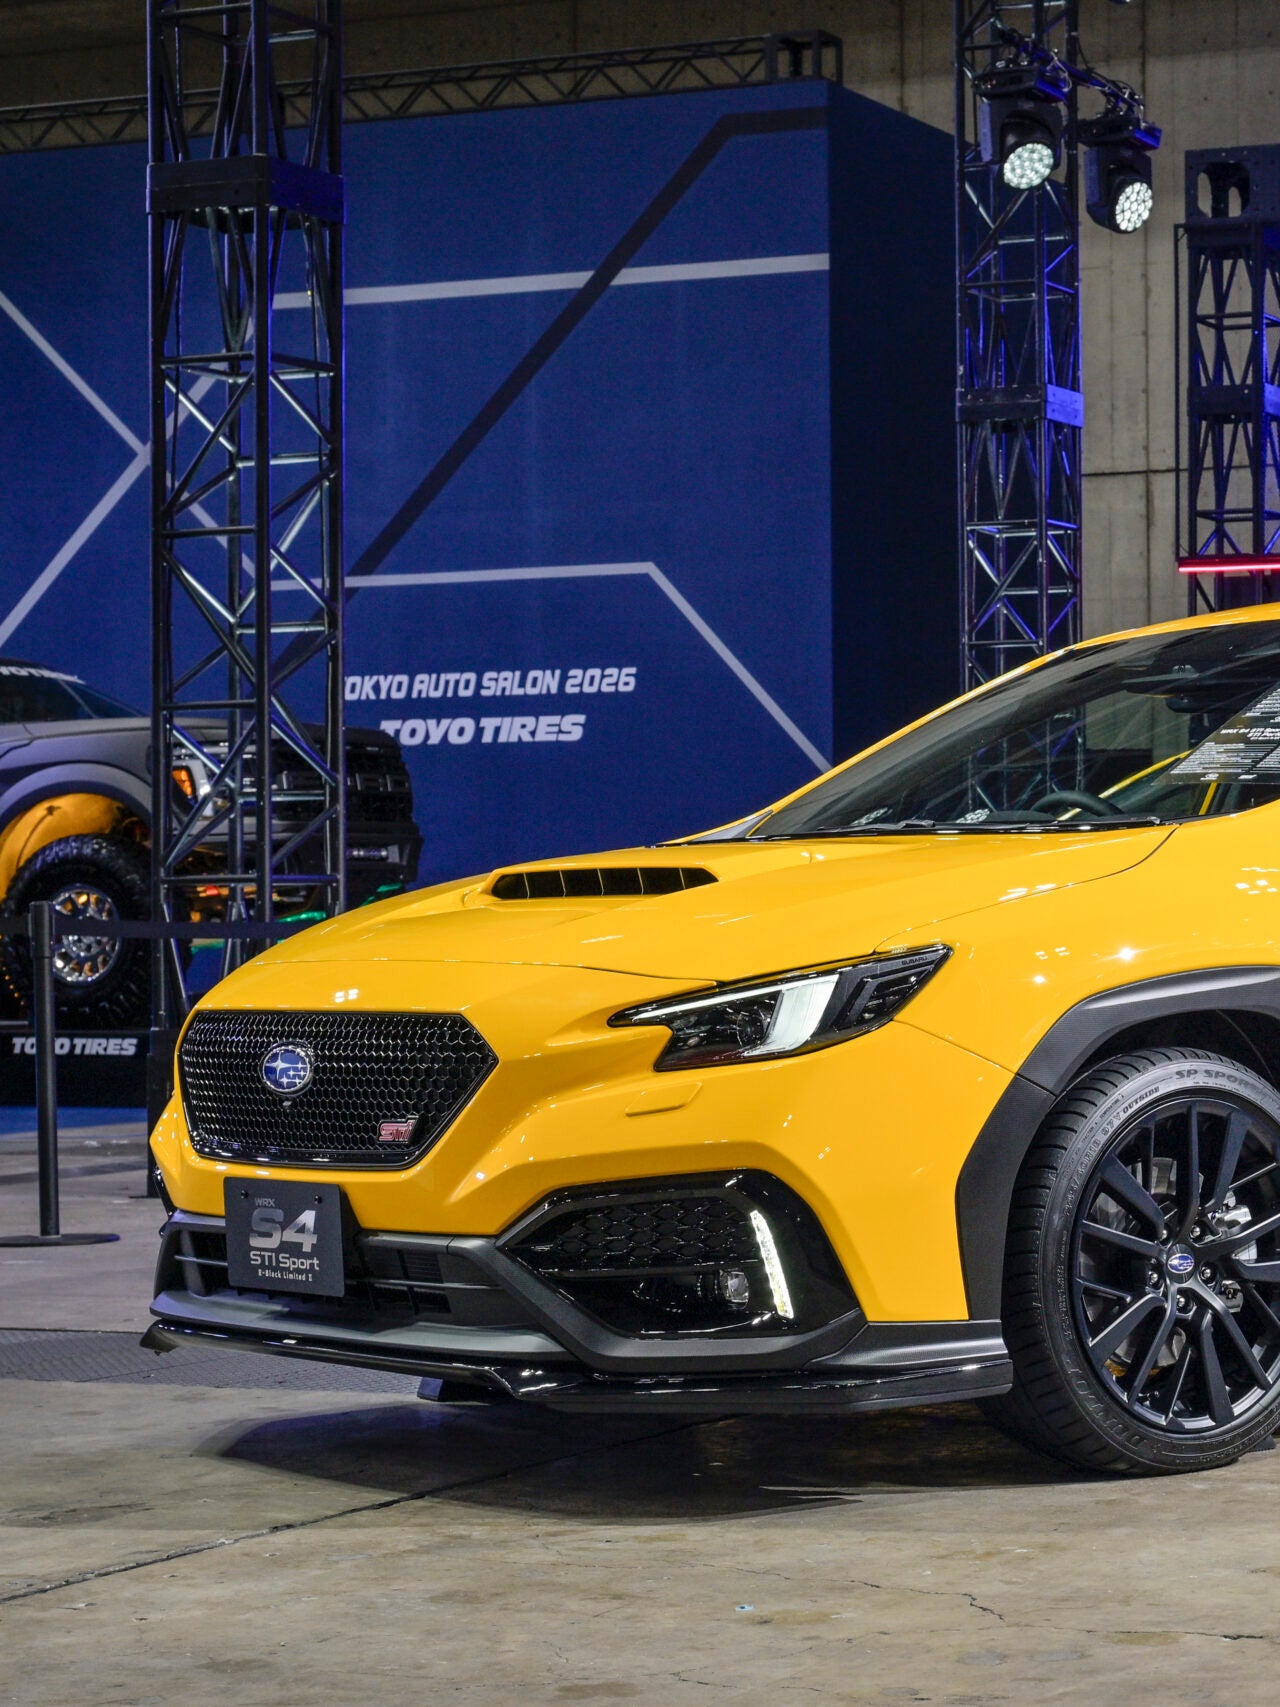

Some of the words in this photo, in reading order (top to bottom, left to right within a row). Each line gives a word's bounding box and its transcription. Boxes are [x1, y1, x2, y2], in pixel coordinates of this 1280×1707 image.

[344, 674, 409, 700] OKYO
[411, 671, 477, 698] AUTO
[480, 669, 561, 696] SALON
[565, 667, 637, 693] 2026
[378, 717, 475, 747] TOYO
[479, 714, 586, 743] TIRES
[12, 1036, 71, 1056] TOO
[72, 1037, 138, 1056] TIRES
[1122, 1086, 1160, 1114] OUTSIDE
[255, 1198, 275, 1207] WRX
[249, 1208, 317, 1252] S4
[250, 1251, 276, 1266] STI
[279, 1254, 319, 1271] Sport
